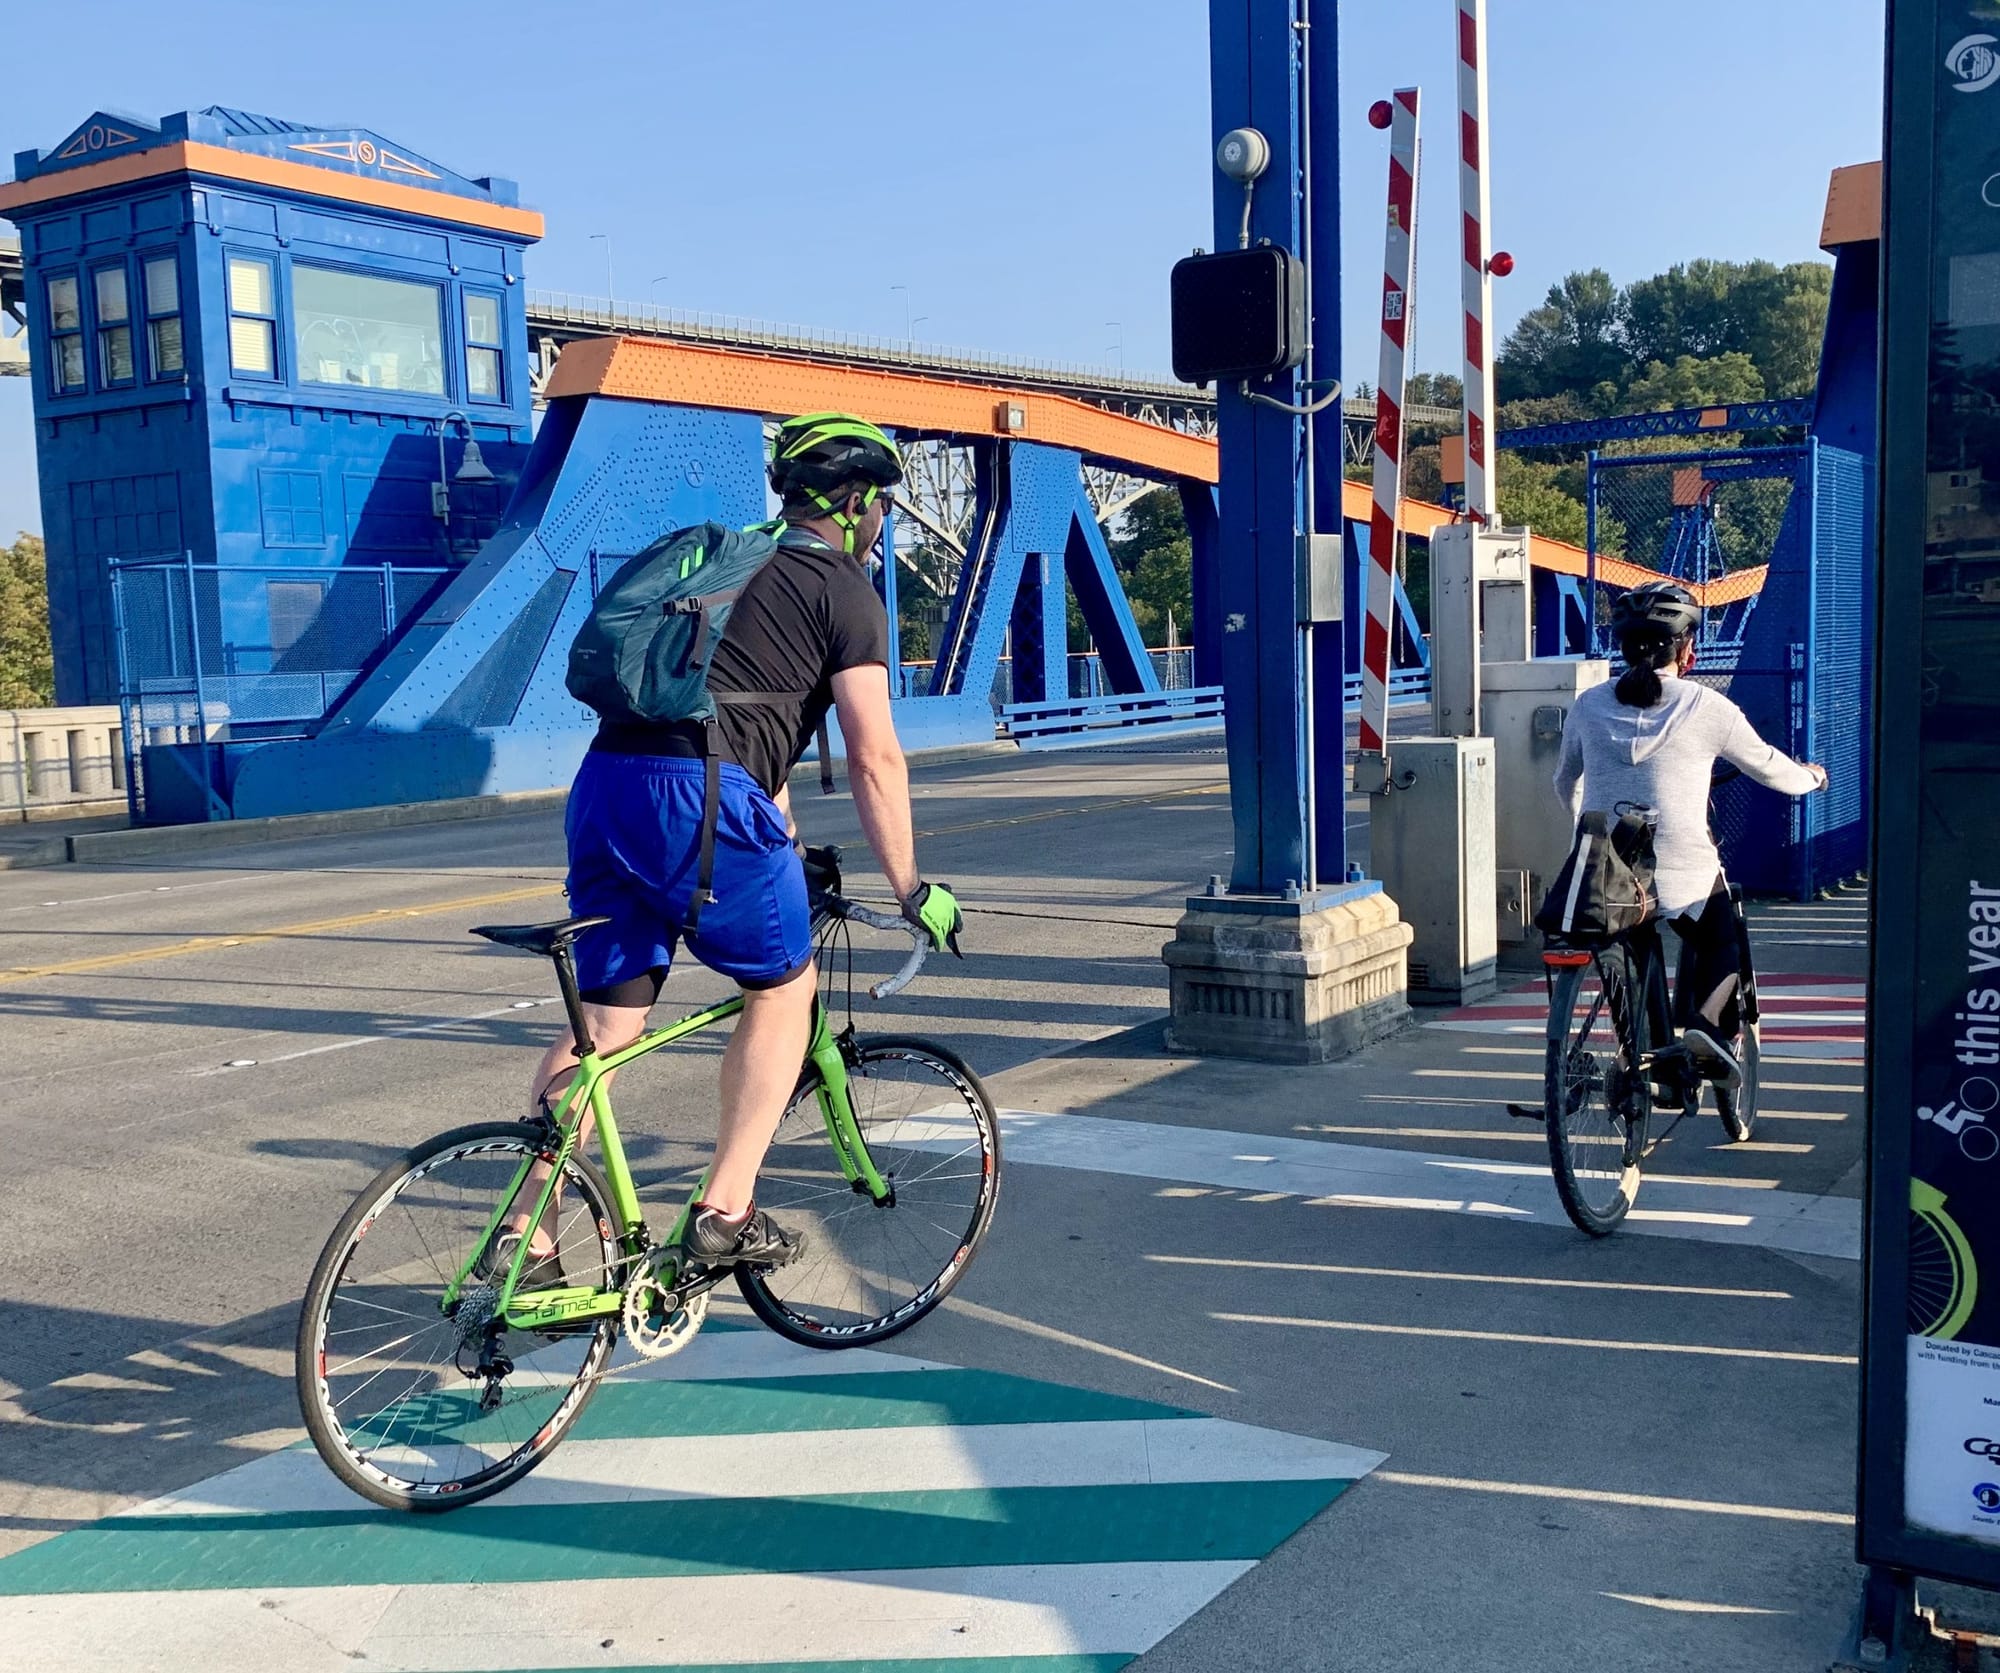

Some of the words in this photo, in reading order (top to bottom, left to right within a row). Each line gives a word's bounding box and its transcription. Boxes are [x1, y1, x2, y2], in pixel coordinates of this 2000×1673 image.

[360, 143, 374, 162] S
[1967, 879, 2000, 974] year
[1954, 987, 2000, 1066] this
[819, 1261, 955, 1335] EASTON
[1917, 1351, 1936, 1360] with
[1937, 1353, 1968, 1367] funding
[1969, 1358, 1990, 1369] from
[1925, 1340, 1960, 1354] Donated
[1961, 1346, 1971, 1357] by
